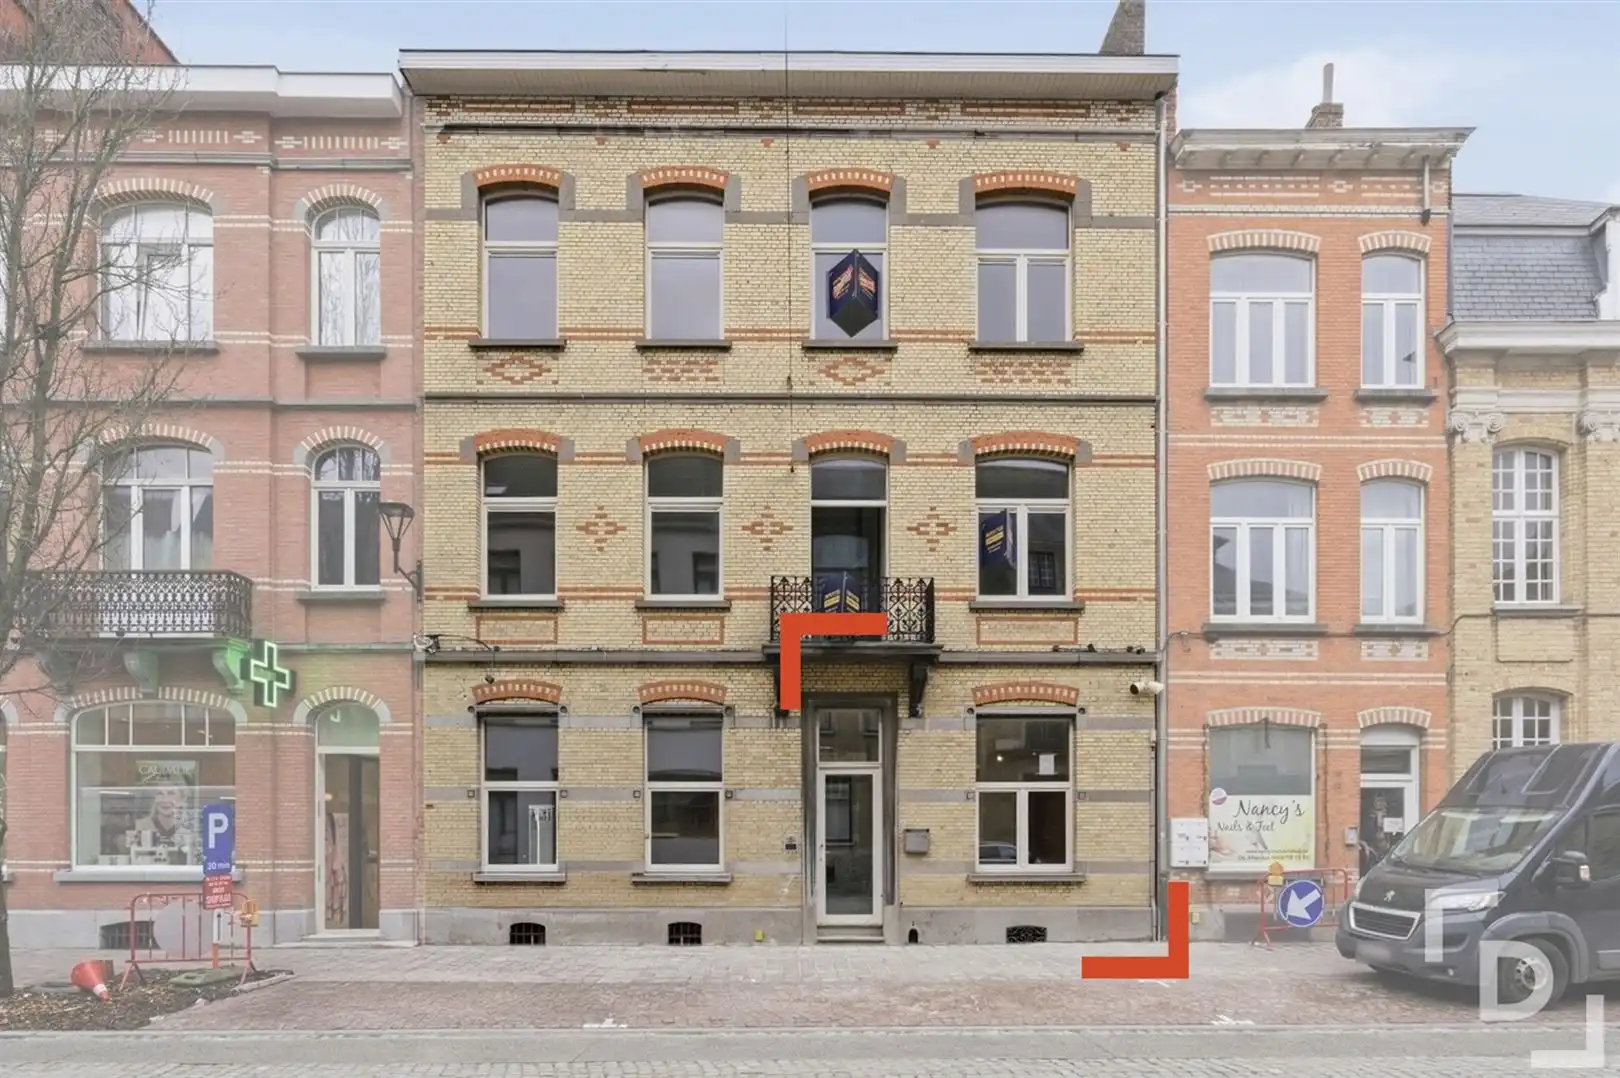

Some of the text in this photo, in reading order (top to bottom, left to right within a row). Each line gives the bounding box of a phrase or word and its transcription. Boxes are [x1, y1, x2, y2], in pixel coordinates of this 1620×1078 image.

[1232, 799, 1305, 824] Nancy's
[208, 812, 229, 849] P
[1217, 820, 1275, 831] Nails & Feet
